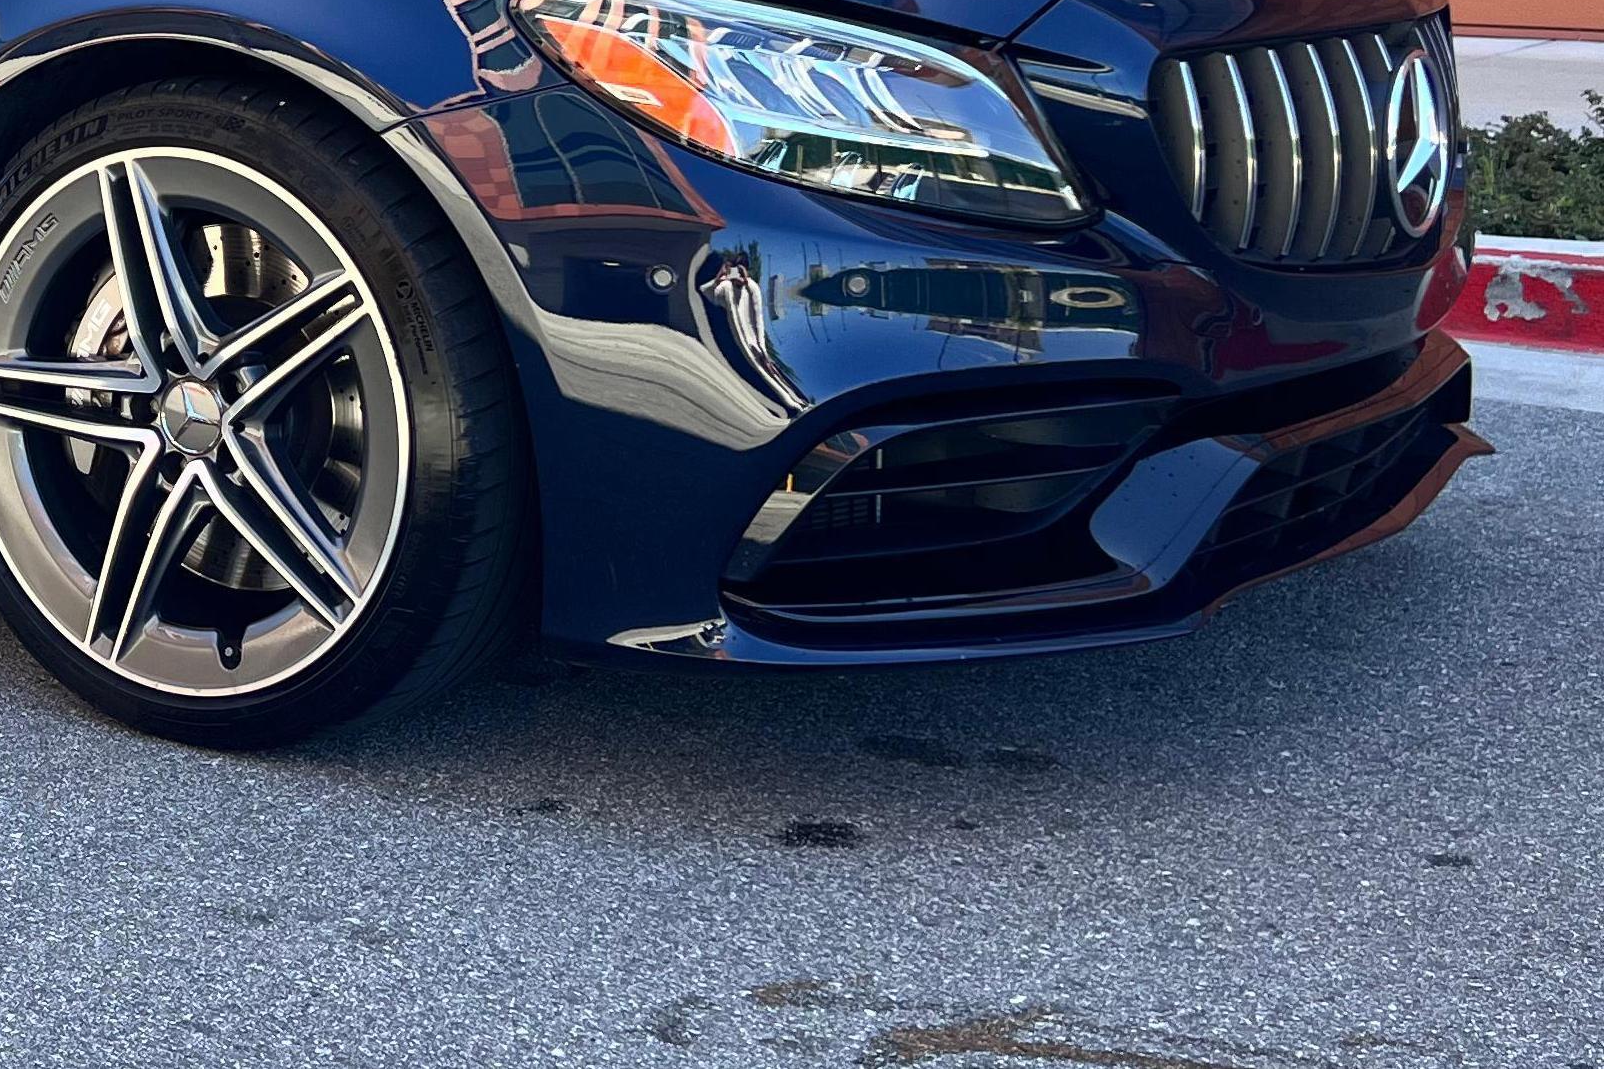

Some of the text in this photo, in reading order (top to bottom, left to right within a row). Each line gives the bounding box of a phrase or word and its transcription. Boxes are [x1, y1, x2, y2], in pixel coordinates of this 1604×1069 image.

[116, 108, 156, 121] PILOT
[157, 108, 205, 121] SPORT
[411, 301, 434, 352] MICHELIN
